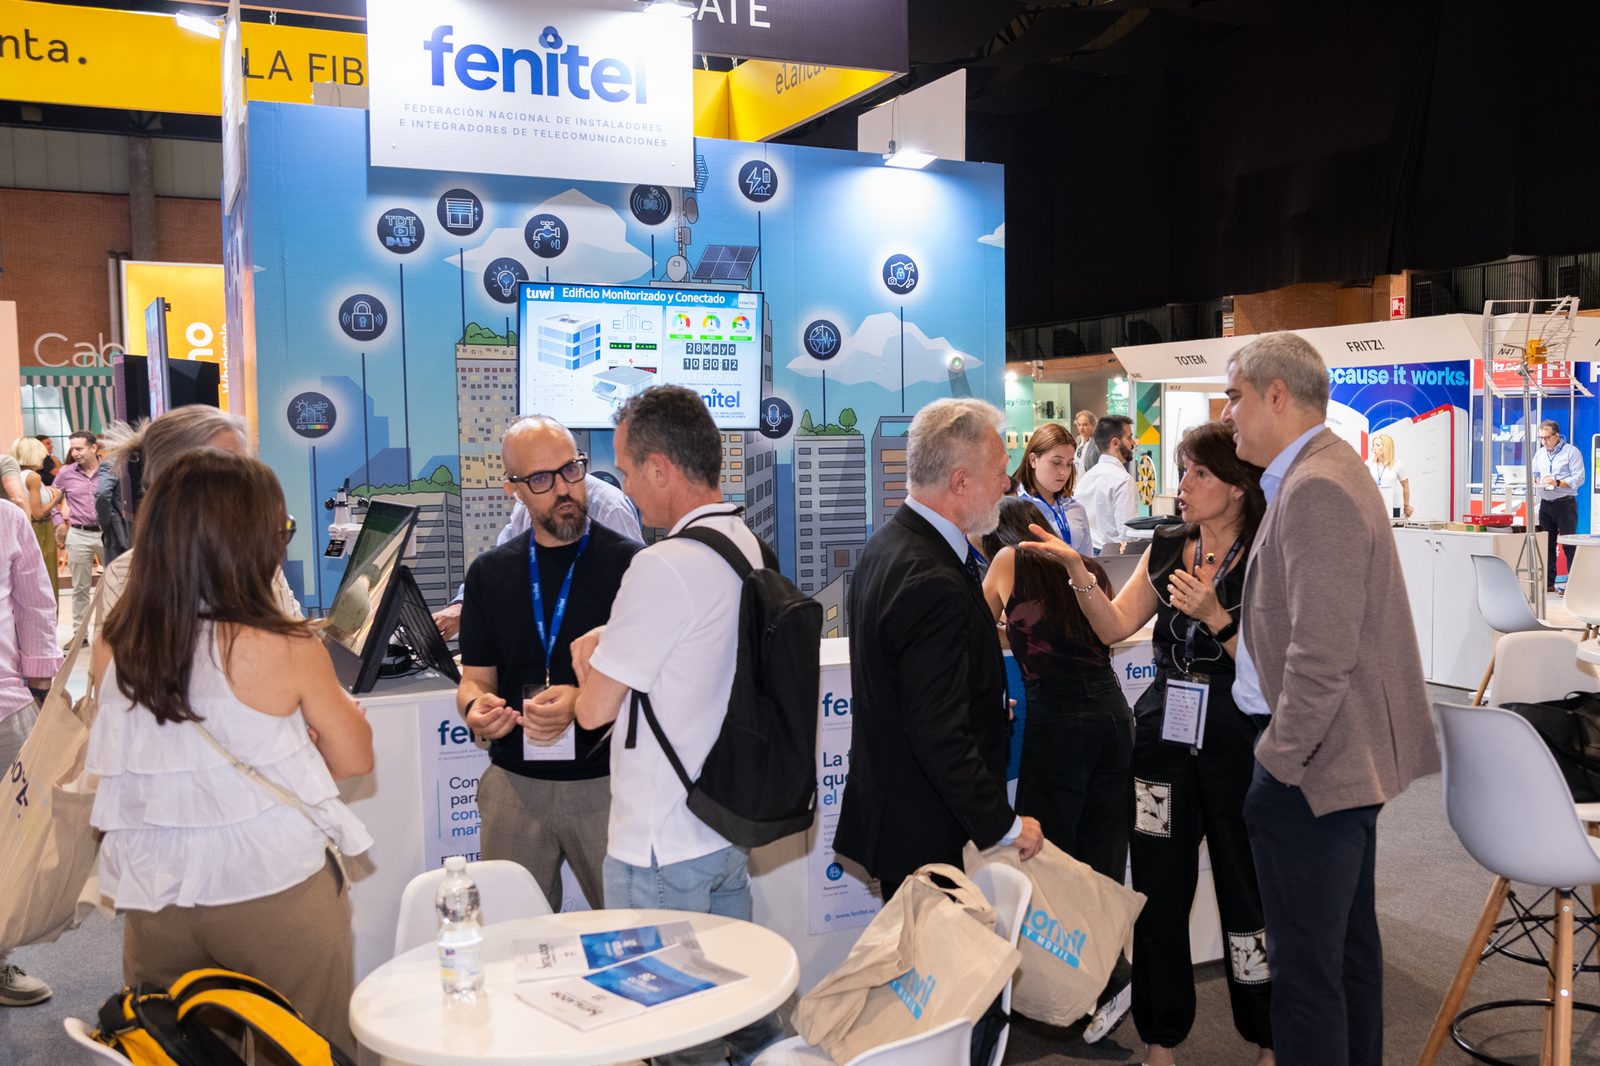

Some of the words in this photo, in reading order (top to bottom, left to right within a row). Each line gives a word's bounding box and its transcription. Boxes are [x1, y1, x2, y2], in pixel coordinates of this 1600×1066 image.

[0, 28, 87, 65] nta.
[244, 48, 293, 81] LA
[309, 53, 364, 87] FIB
[424, 25, 647, 104] fenitel
[404, 103, 484, 118] FEDERACIÓN
[489, 110, 551, 123] NACIONAL
[557, 116, 571, 125] DE
[576, 118, 663, 132] INSTALADORES
[399, 118, 406, 127] E
[411, 119, 507, 135] INTEGRADORES
[513, 127, 527, 137] DE
[533, 129, 667, 147] TELECOMUNICACIONES
[385, 216, 416, 226] TDT
[526, 287, 554, 300] tuwi
[562, 287, 600, 299] Edificio
[601, 289, 666, 302] Monitorizado
[667, 293, 674, 304] y
[675, 292, 726, 304] Conectado
[34, 332, 124, 367] Cab
[1346, 339, 1385, 352] FRITZ!
[1174, 354, 1207, 365] TOTEM
[1393, 364, 1407, 385] it
[1411, 367, 1470, 386] works.
[823, 752, 842, 768] La
[823, 789, 837, 805] el
